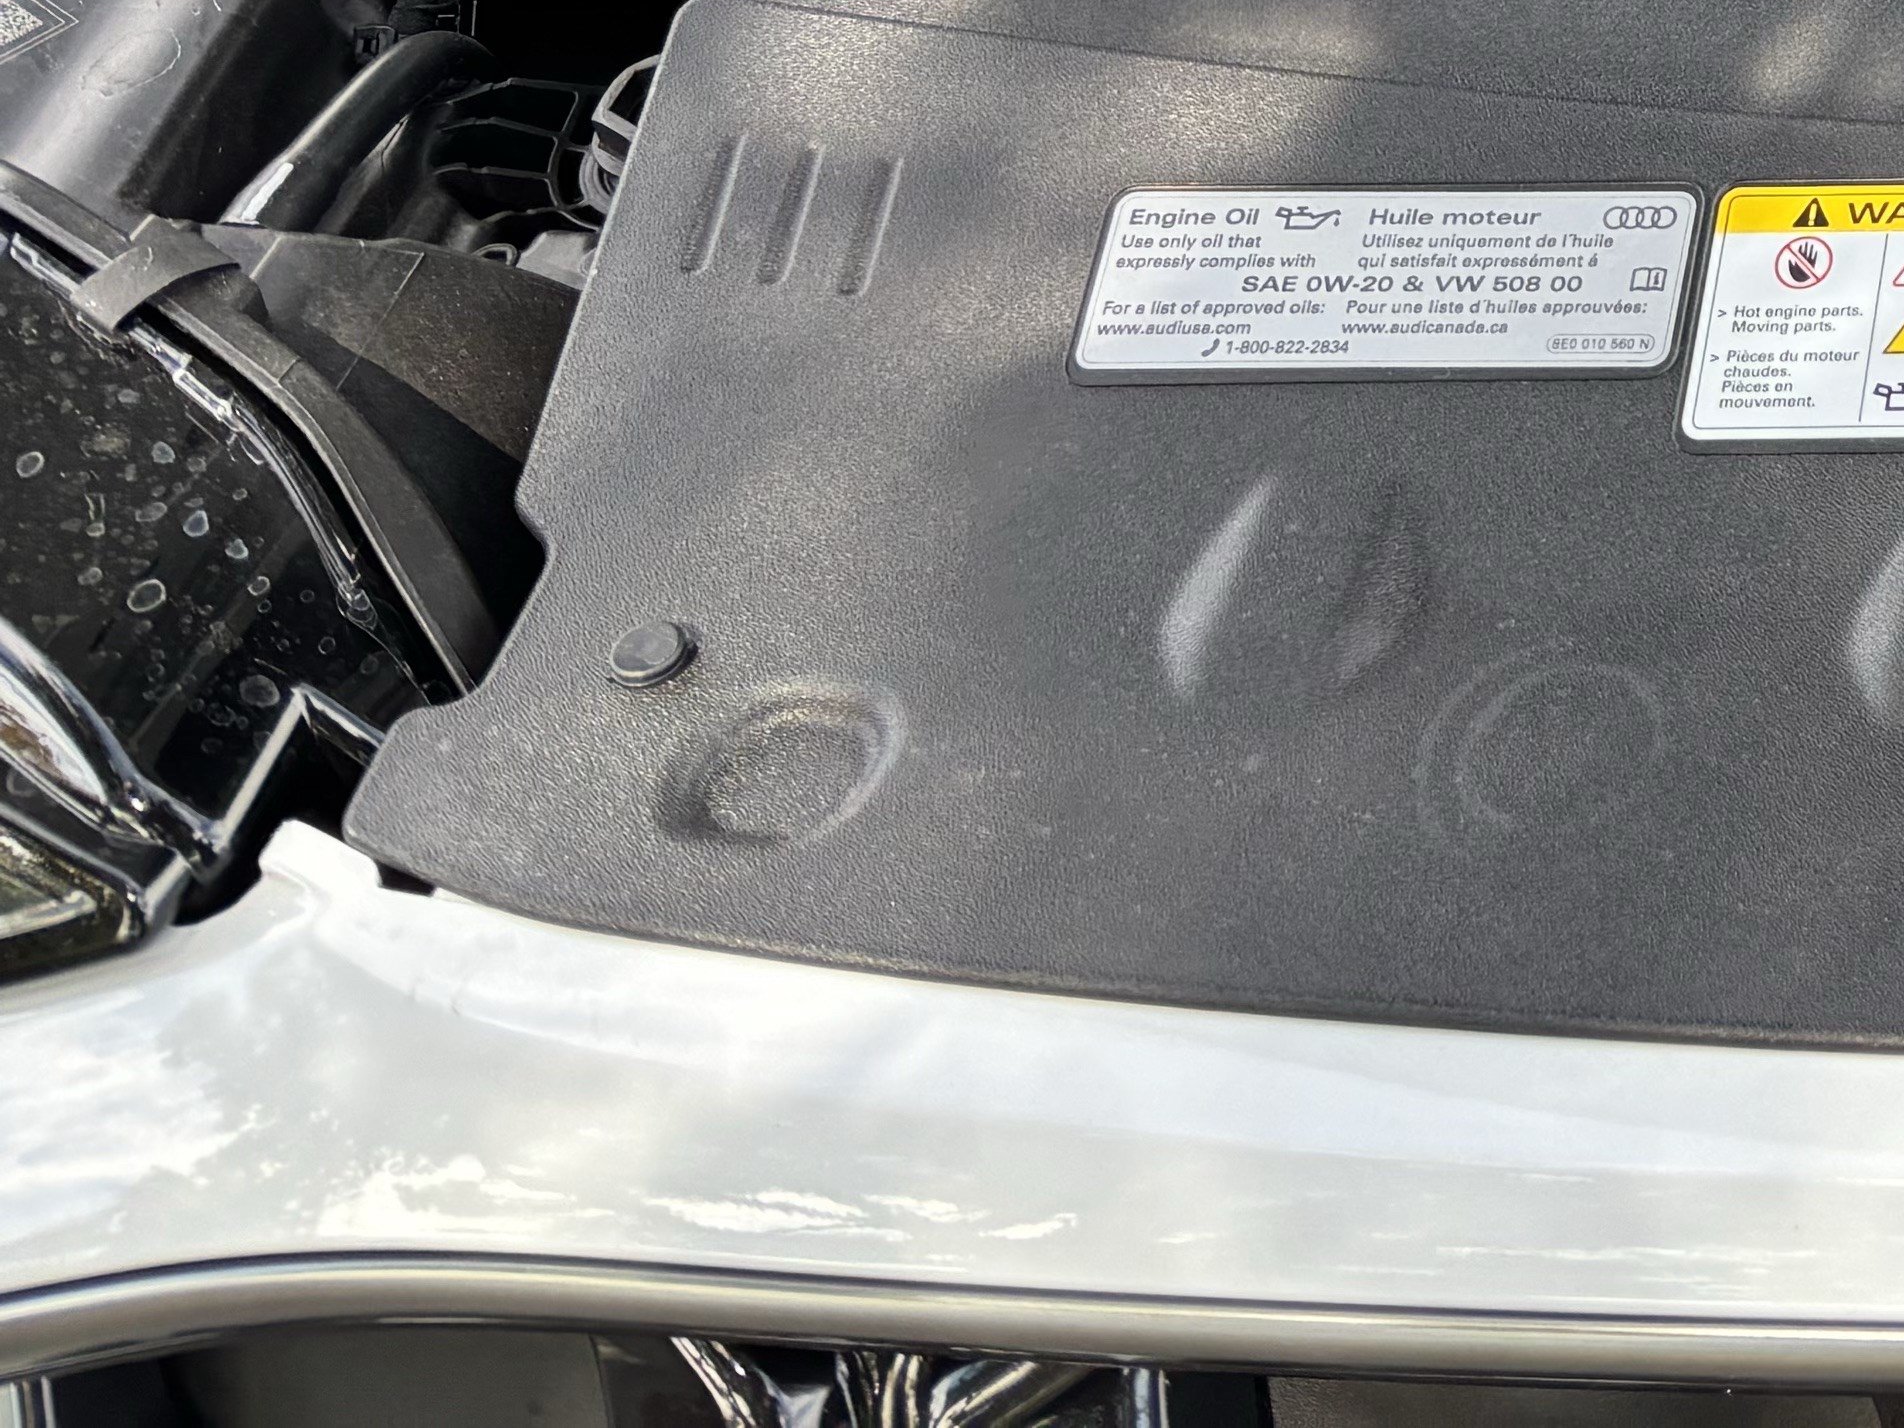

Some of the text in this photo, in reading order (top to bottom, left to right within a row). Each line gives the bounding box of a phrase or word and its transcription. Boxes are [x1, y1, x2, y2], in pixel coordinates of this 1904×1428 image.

[1129, 207, 1260, 230] Engine Oil
[1369, 208, 1542, 227] Huile moteur
[1121, 233, 1262, 251] Use only oil that
[1362, 233, 1424, 249] Utilisez
[1428, 233, 1531, 251] uniquement
[1536, 233, 1558, 249] de
[1116, 253, 1316, 271] expressly complies with
[1358, 253, 1387, 271] qui
[1390, 253, 1458, 268] satisfait
[1462, 253, 1584, 271] expressément
[1241, 275, 1583, 293] SAE 0W-20 & VW 508 00
[1102, 299, 1326, 318] For a list of approved oils:
[1346, 300, 1387, 315] Pour
[1391, 303, 1423, 315] une
[1428, 299, 1464, 315] liste
[1734, 304, 1864, 320] Hot engine parts.
[1097, 319, 1252, 336] www.audiusa.com
[1341, 318, 1509, 335] www.audicanada.ca
[1731, 320, 1836, 336] Moving parts.
[1226, 339, 1350, 356] 1-800-822-2834
[1779, 349, 1799, 362] du
[1803, 350, 1860, 362] moteur
[1723, 365, 1791, 378] chaudes.
[1774, 381, 1793, 392] en
[1719, 396, 1815, 409] mouvement.
